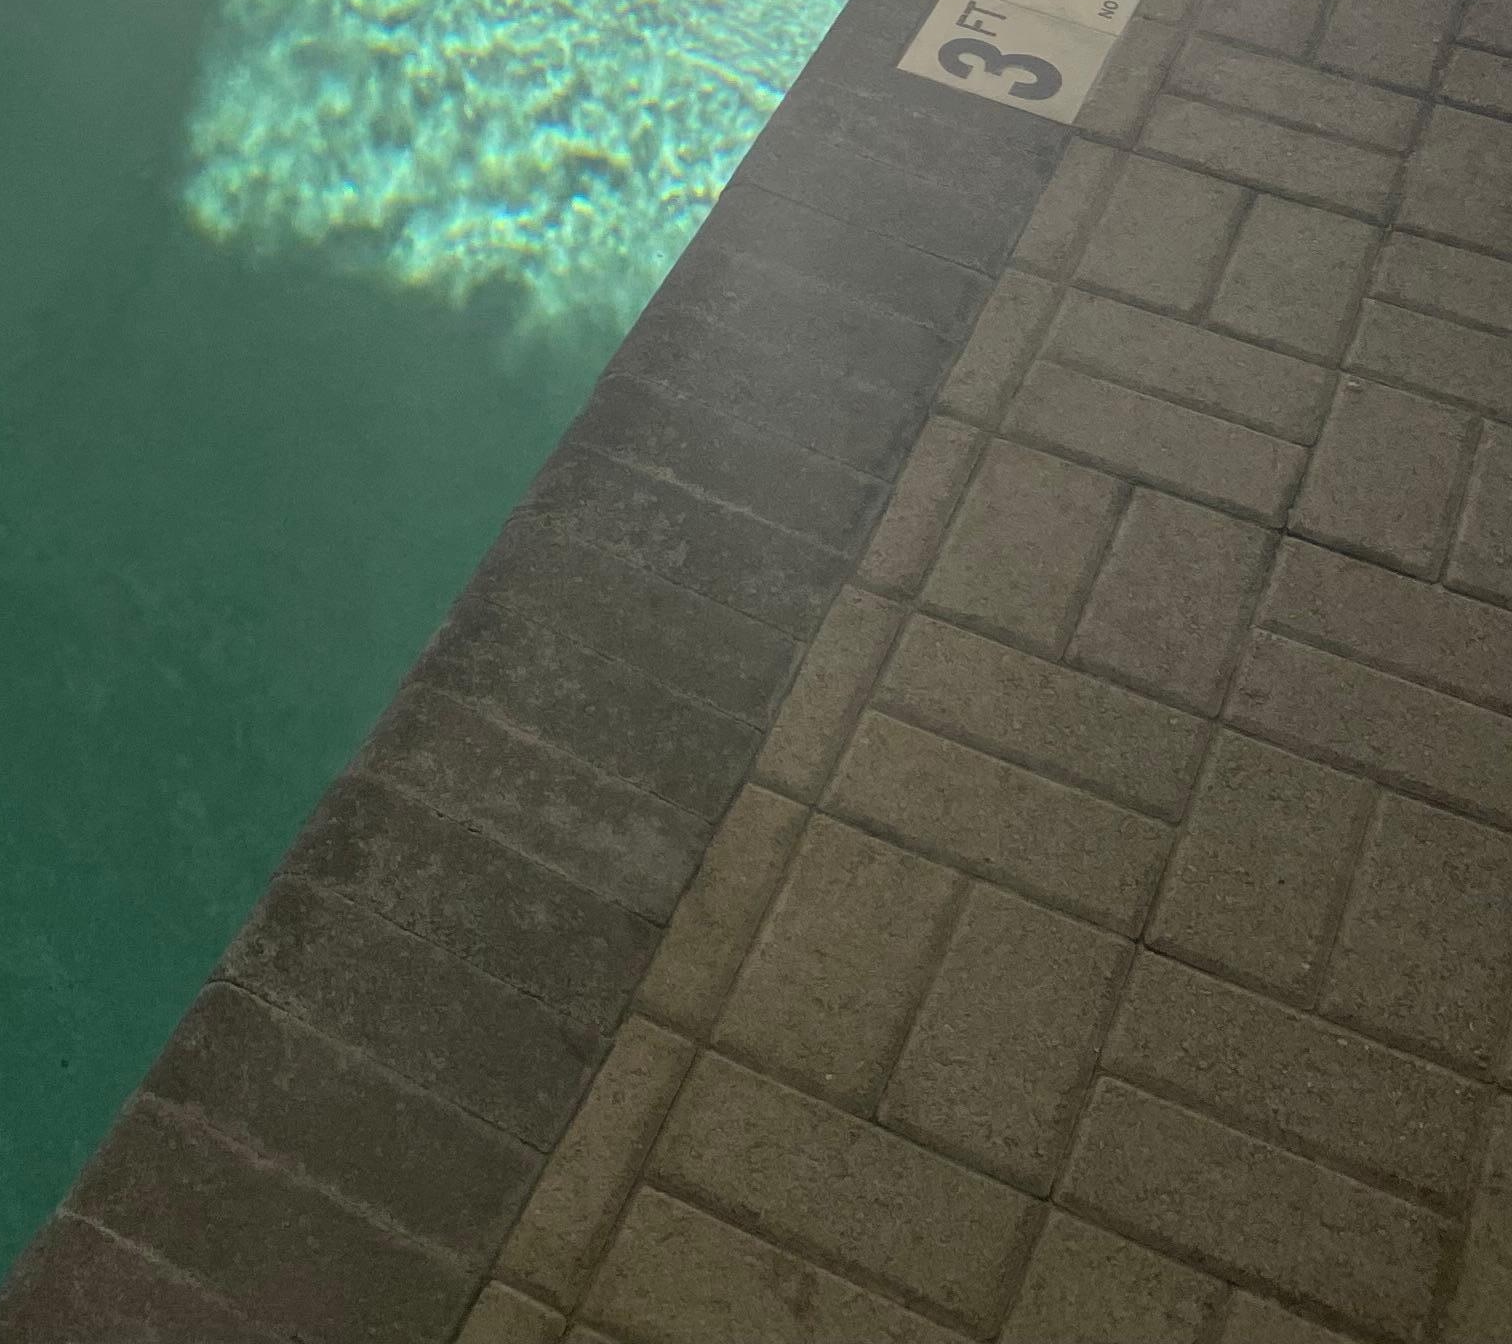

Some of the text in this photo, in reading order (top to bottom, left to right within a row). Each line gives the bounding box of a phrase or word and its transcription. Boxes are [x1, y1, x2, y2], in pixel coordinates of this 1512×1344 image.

[1098, 0, 1120, 20] NO
[938, 0, 1062, 100] 3 FT
